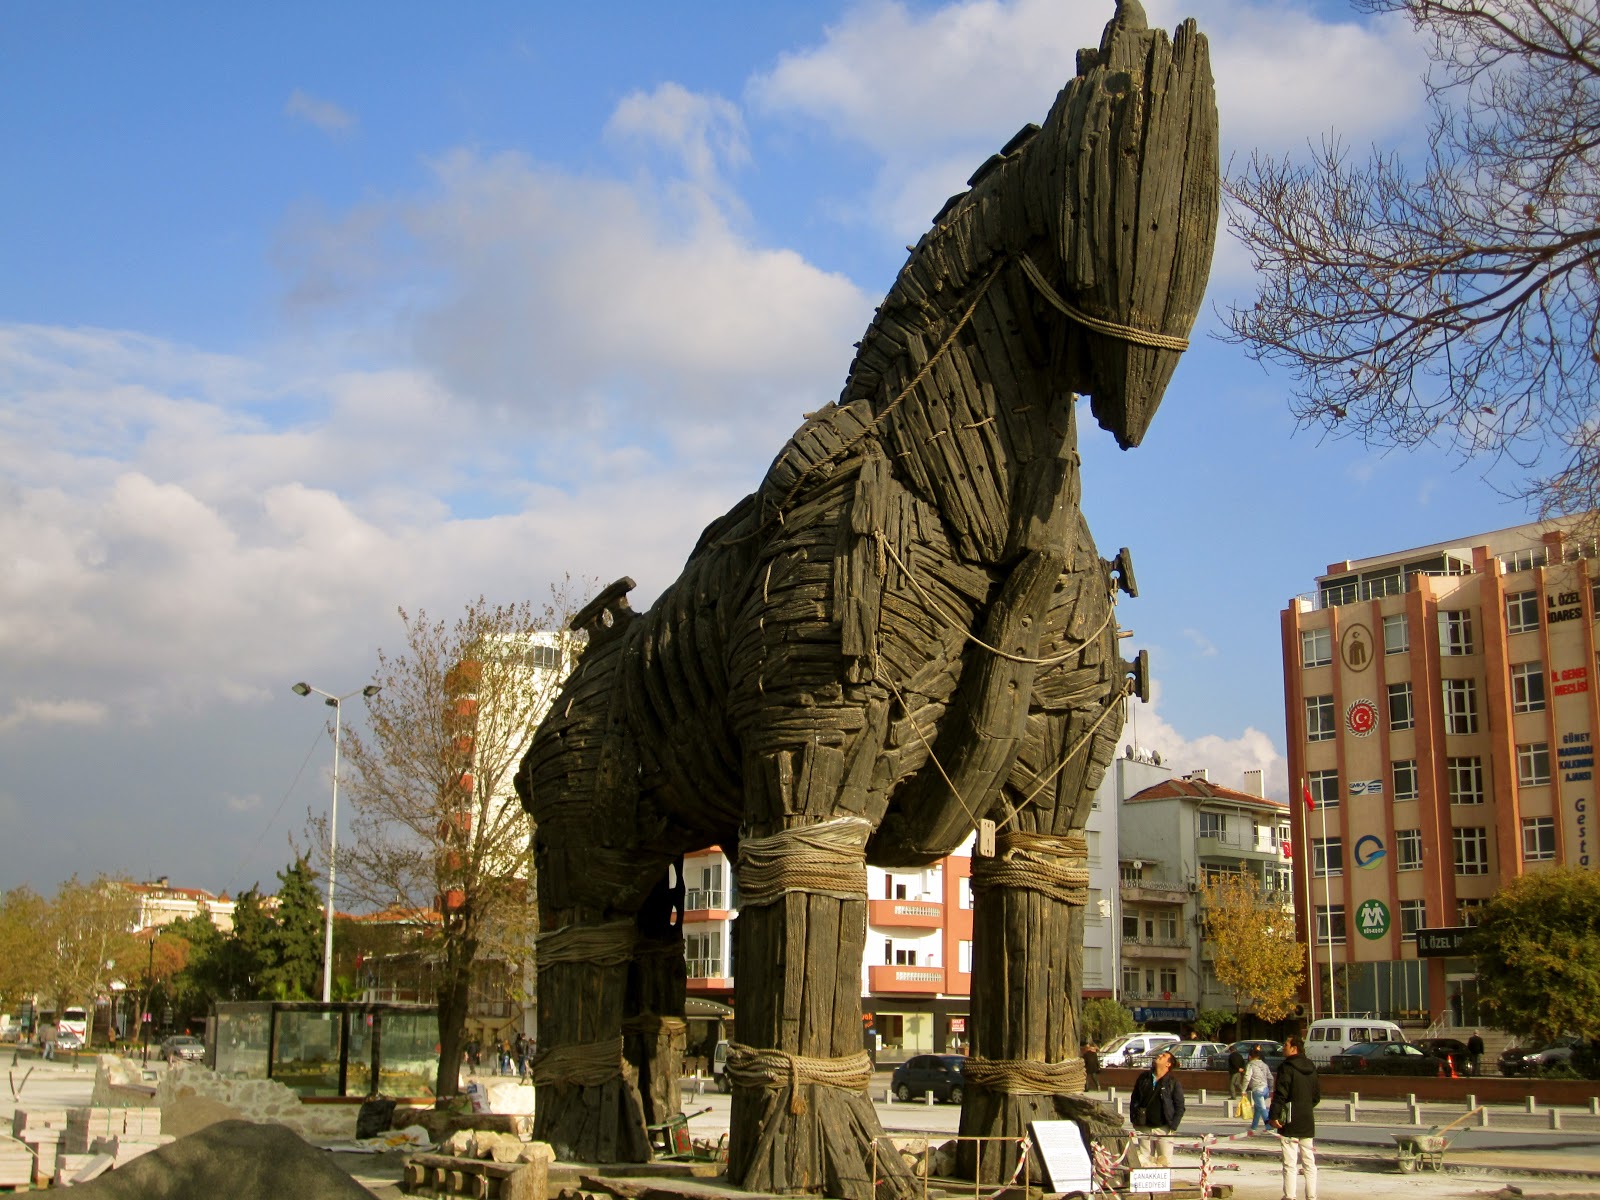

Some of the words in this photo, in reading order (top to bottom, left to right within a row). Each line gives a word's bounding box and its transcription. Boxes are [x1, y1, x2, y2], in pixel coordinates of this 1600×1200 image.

[1558, 592, 1581, 606] ÖZEL
[1563, 732, 1590, 744] GÜNEY
[1574, 797, 1589, 871] Gesta
[1429, 935, 1451, 949] ÖZEL
[1133, 1172, 1168, 1181] ÇANAKKALE
[1133, 1180, 1167, 1189] BELEDİYESİ
